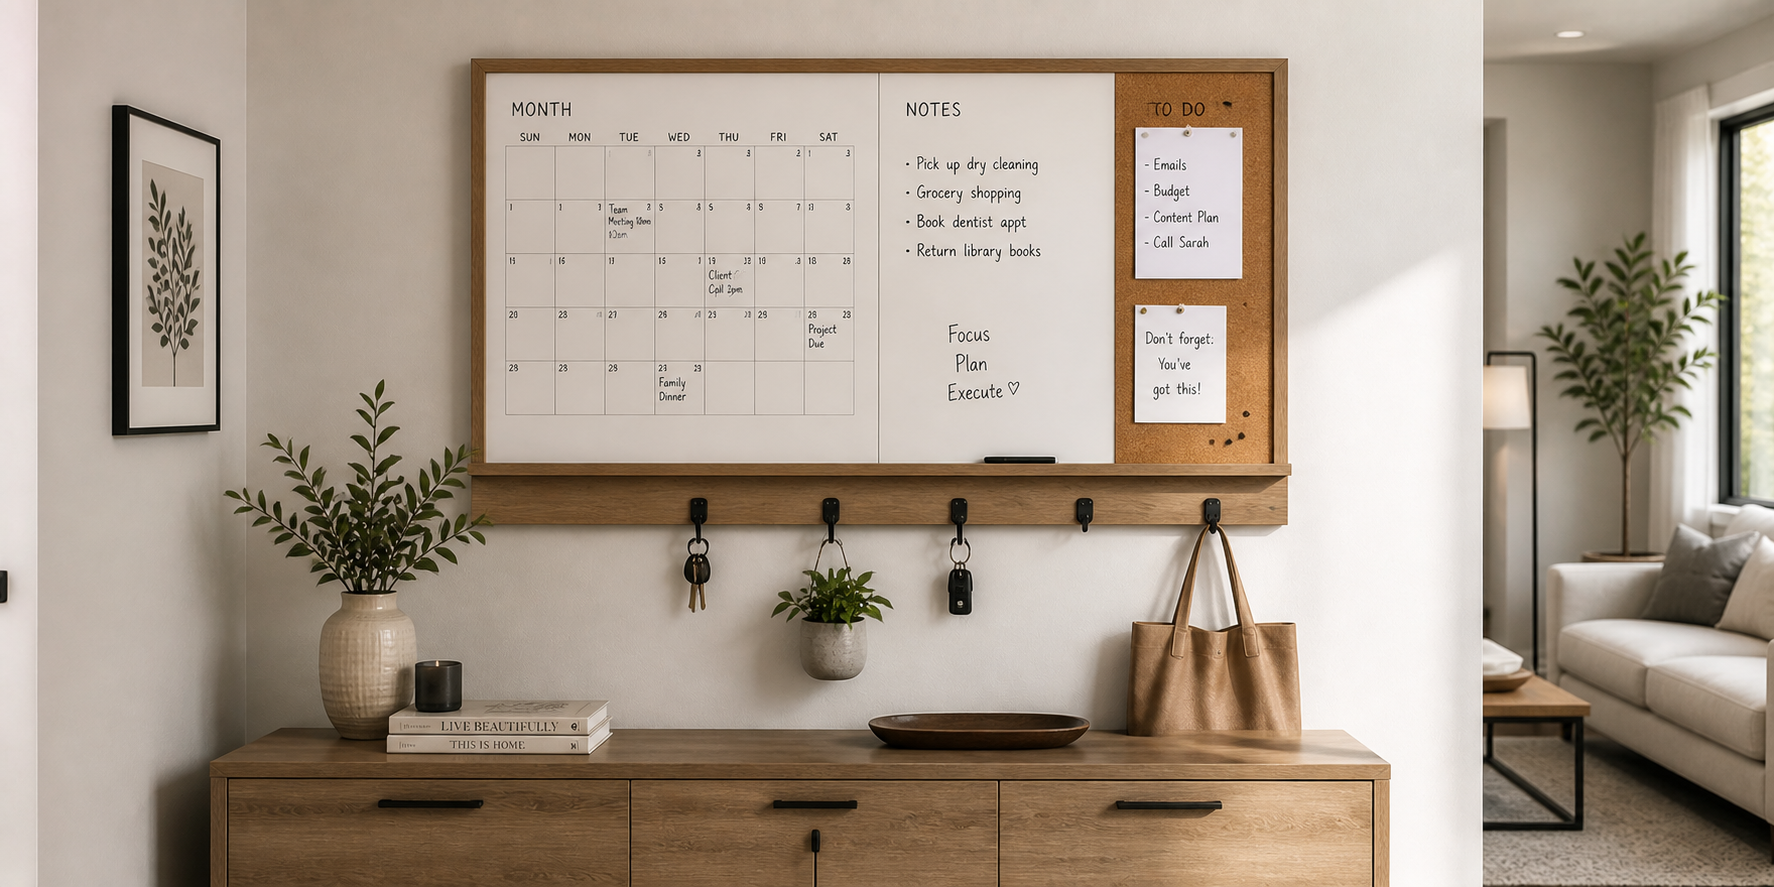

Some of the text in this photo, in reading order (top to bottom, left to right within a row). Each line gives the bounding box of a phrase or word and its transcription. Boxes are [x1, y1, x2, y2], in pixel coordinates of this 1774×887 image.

[512, 102, 572, 116] MONTH
[906, 102, 961, 116] NOTES
[1148, 101, 1206, 117] TO DO
[519, 132, 838, 141] SUN MON TUE WED THU FRI SAT
[916, 156, 1039, 176] Pick up dry cleaning
[1153, 158, 1187, 170] Emails
[916, 185, 1021, 204] Grocery shopping
[1153, 184, 1190, 202] Budget
[608, 204, 628, 214] Team
[1153, 210, 1219, 222] Content Plan
[916, 214, 1027, 232] Book dentist appt
[1153, 236, 1209, 248] Call Sarah
[917, 243, 1042, 262] Return library books
[708, 270, 732, 280] Client
[808, 324, 837, 339] Project
[948, 324, 991, 343] Focus
[808, 338, 825, 348] Due
[1145, 331, 1214, 350] Don't forget:
[955, 354, 988, 372] Plan
[1157, 358, 1191, 370] You've
[658, 377, 686, 391] Family
[1152, 382, 1201, 400] got this!
[659, 390, 687, 401] Dinner
[948, 383, 1004, 401] Execute
[441, 721, 471, 731] LIVE
[474, 722, 559, 731] BEAUTIFULLY
[448, 740, 526, 750] THIS IS HOME
